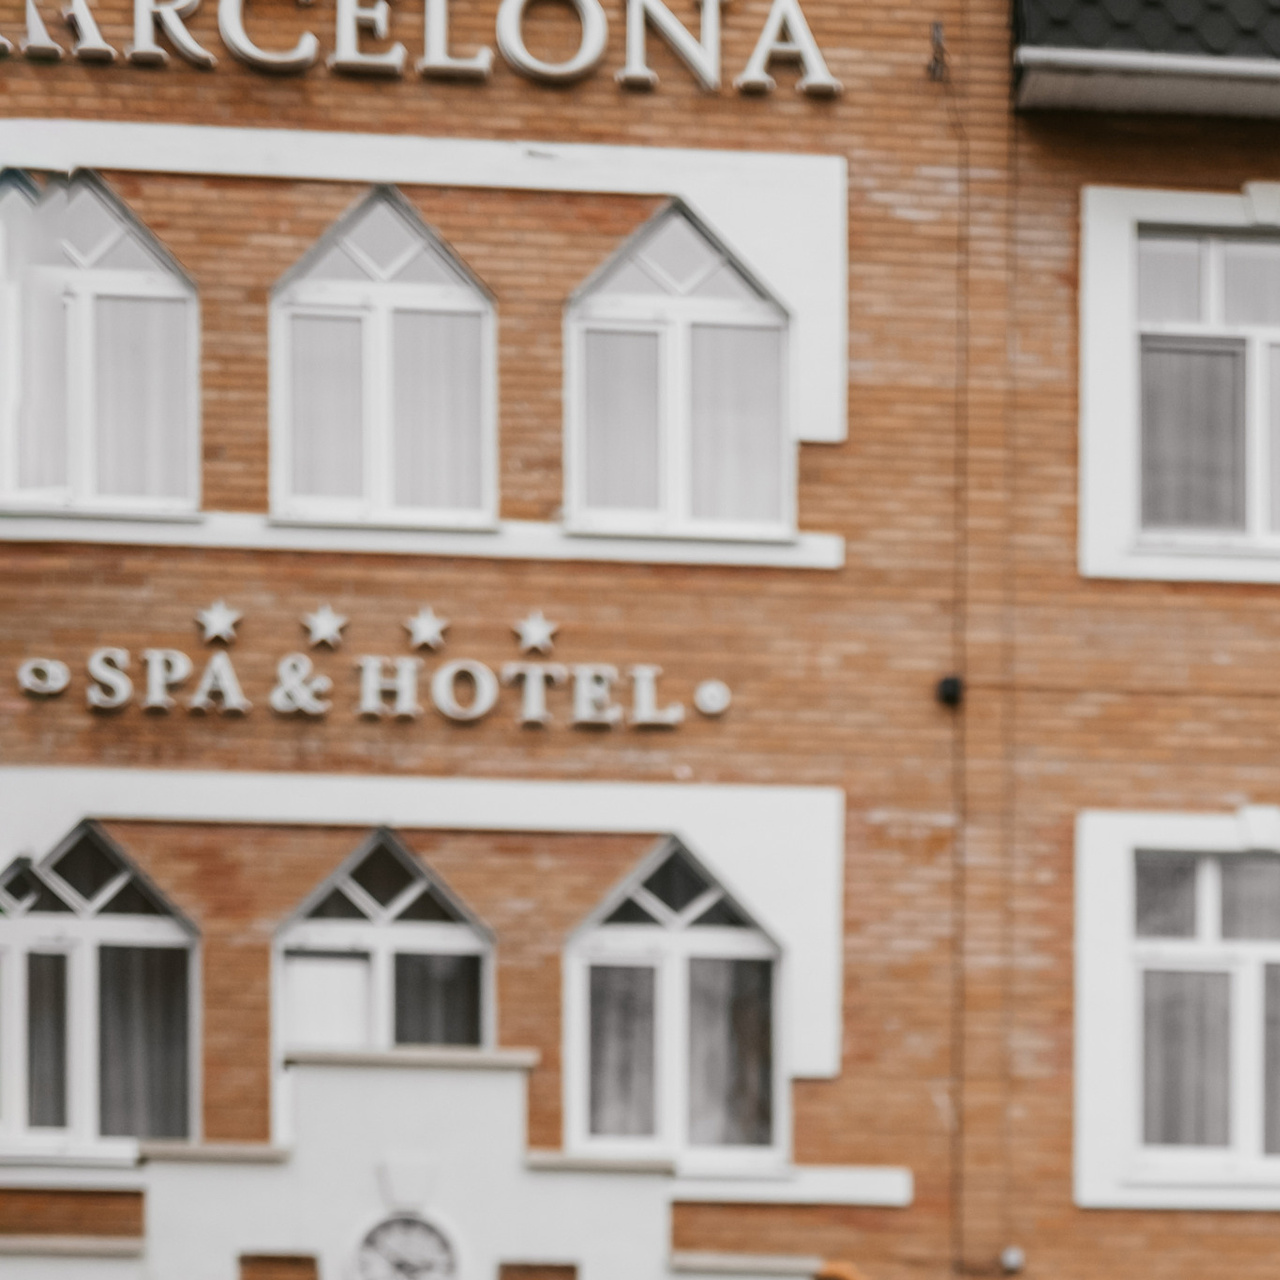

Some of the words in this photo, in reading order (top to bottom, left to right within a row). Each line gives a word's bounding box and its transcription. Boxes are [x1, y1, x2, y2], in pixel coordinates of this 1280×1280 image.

[0, 0, 844, 93] ARCELONA
[86, 646, 251, 711] SPA
[268, 652, 334, 715] &
[351, 655, 685, 727] HOTEL
